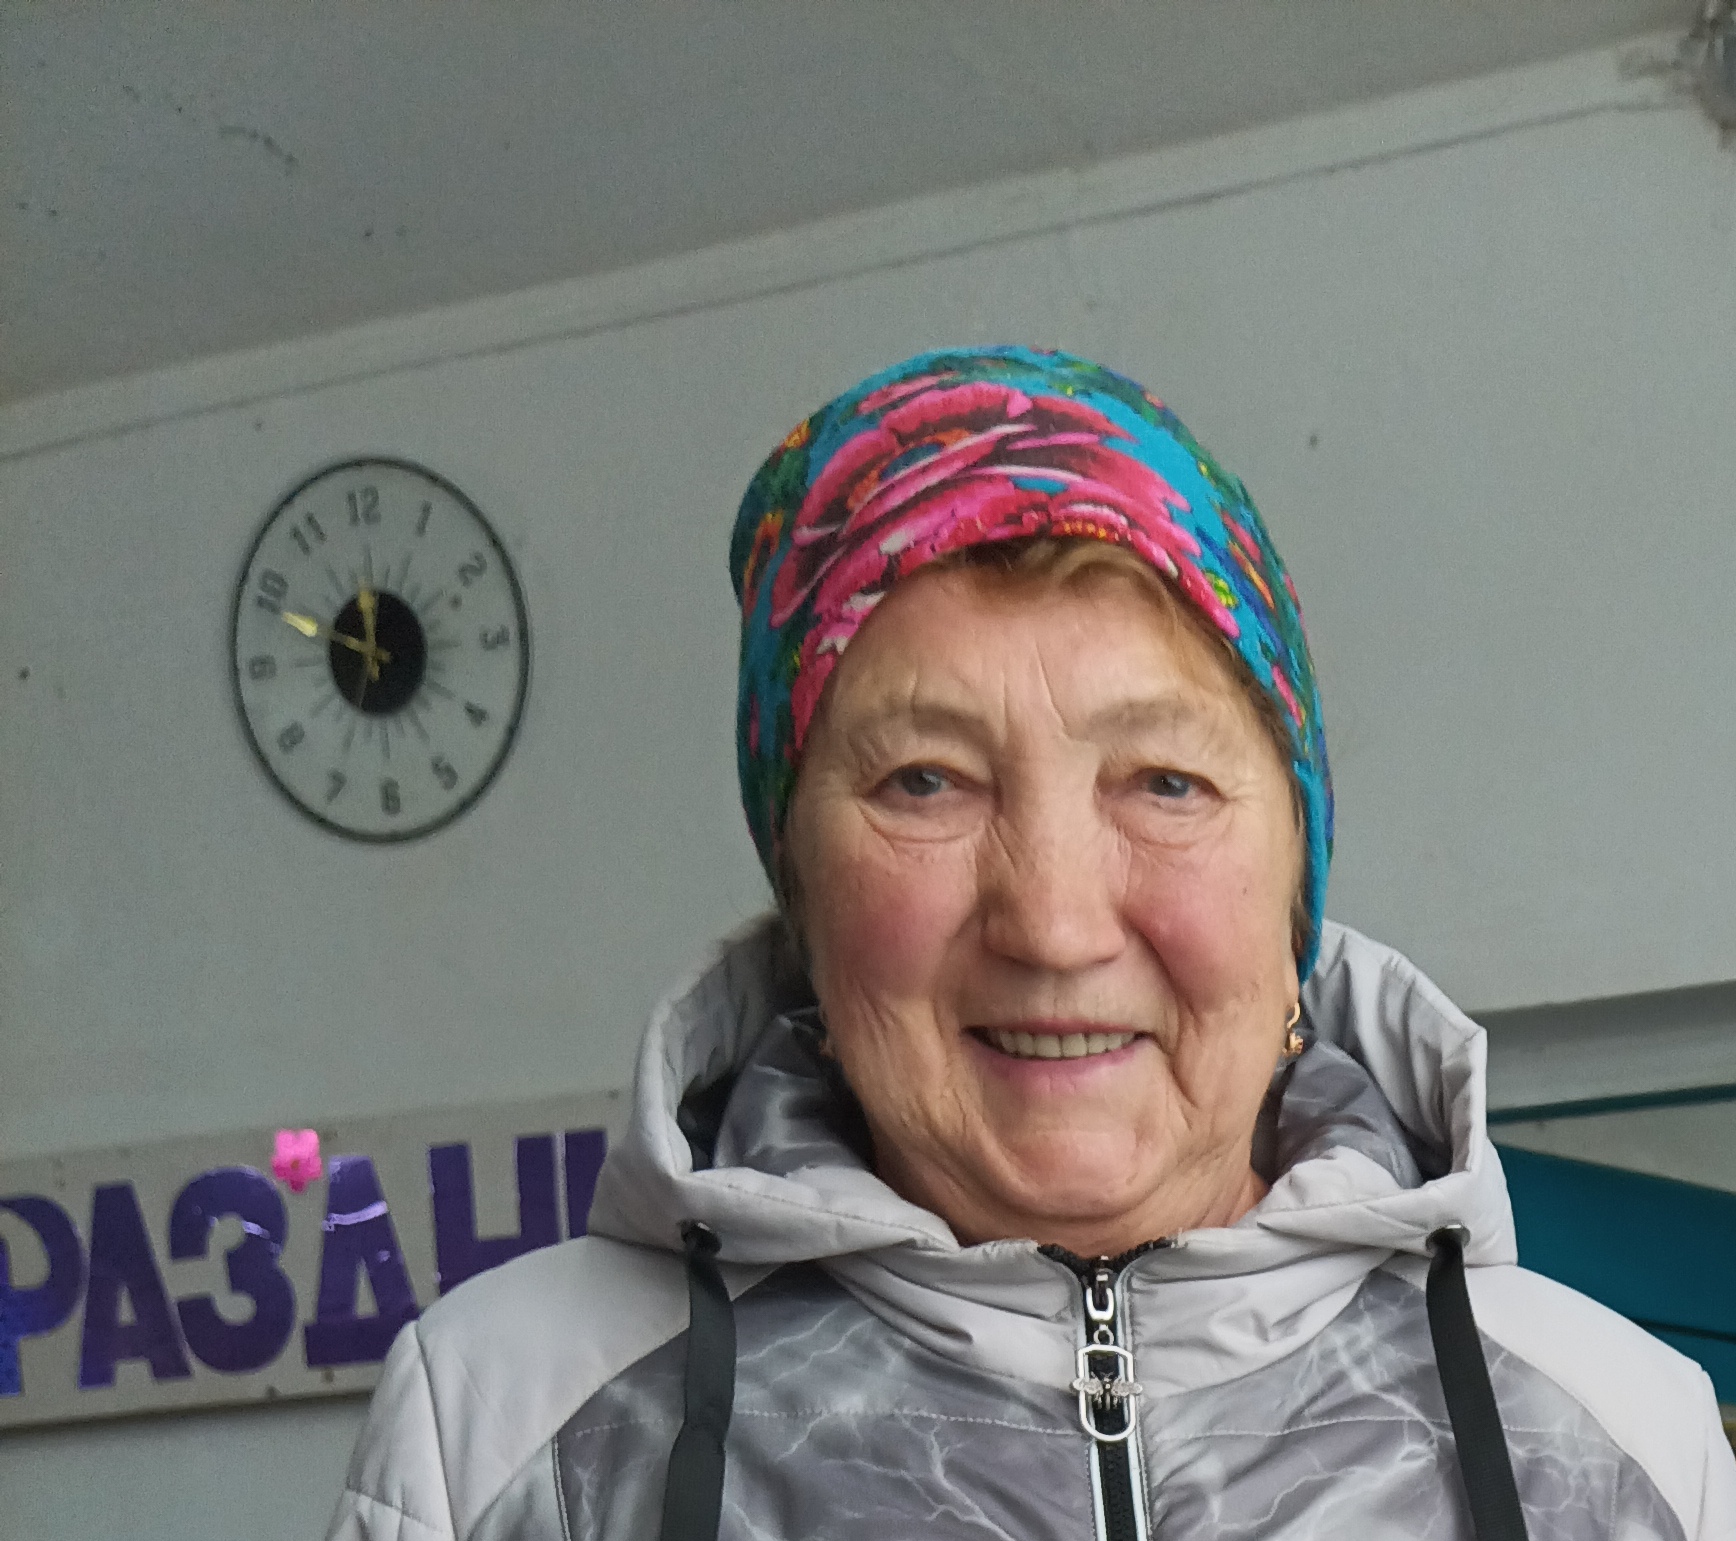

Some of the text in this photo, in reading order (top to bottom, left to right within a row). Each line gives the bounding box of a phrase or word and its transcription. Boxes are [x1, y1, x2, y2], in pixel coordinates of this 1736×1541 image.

[346, 485, 381, 526] 12
[415, 500, 432, 537] 1
[289, 511, 327, 556] 11
[458, 551, 488, 588] 2
[256, 568, 290, 615] 10
[479, 625, 511, 652] 3
[248, 655, 277, 682] 9
[464, 700, 490, 728] 4
[277, 722, 305, 754] 8
[325, 767, 347, 803] 7
[431, 755, 459, 791] 5
[380, 776, 401, 816] 6
